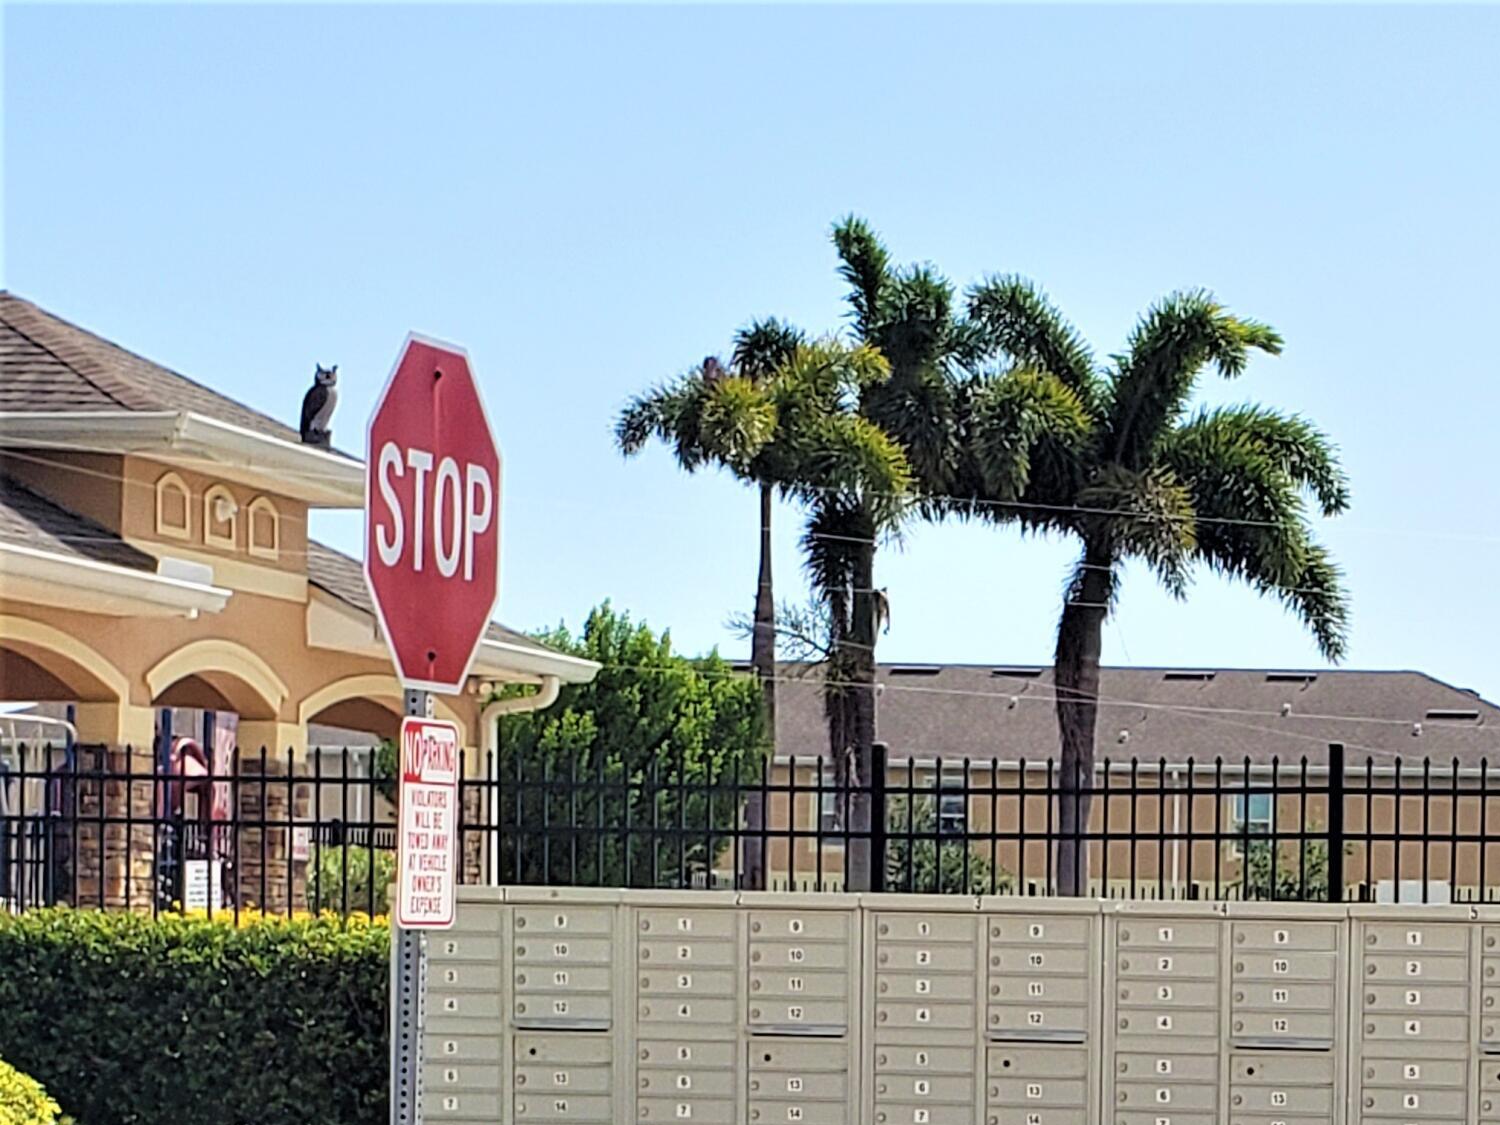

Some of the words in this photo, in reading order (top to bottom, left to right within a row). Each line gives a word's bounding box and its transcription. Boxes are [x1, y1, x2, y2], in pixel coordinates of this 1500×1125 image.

[375, 440, 493, 582] STOP
[405, 731, 422, 777] NO
[422, 735, 454, 772] PARKING
[410, 789, 448, 809] VIOLATORS
[415, 810, 431, 829] WILL
[433, 811, 442, 830] BE
[408, 831, 429, 850] TOWED
[432, 832, 449, 851] AWAY
[409, 852, 416, 871] AT
[418, 853, 447, 873] VEHICLE
[412, 874, 442, 893] OWNER'S
[410, 895, 441, 915] EXPENSE
[791, 950, 802, 960] 10
[1030, 955, 1042, 965] 10
[1275, 961, 1287, 972] 10
[791, 979, 801, 989] 11
[1031, 984, 1041, 994] 11
[1275, 991, 1286, 1001] 11
[790, 1008, 802, 1018] 12
[1030, 1014, 1042, 1024] 12
[1275, 1020, 1286, 1031] 12
[790, 1079, 800, 1089] 13
[1029, 1086, 1040, 1096] 13
[1273, 1094, 1285, 1104] 13
[790, 1108, 800, 1117] 14
[1029, 1115, 1039, 1124] 14
